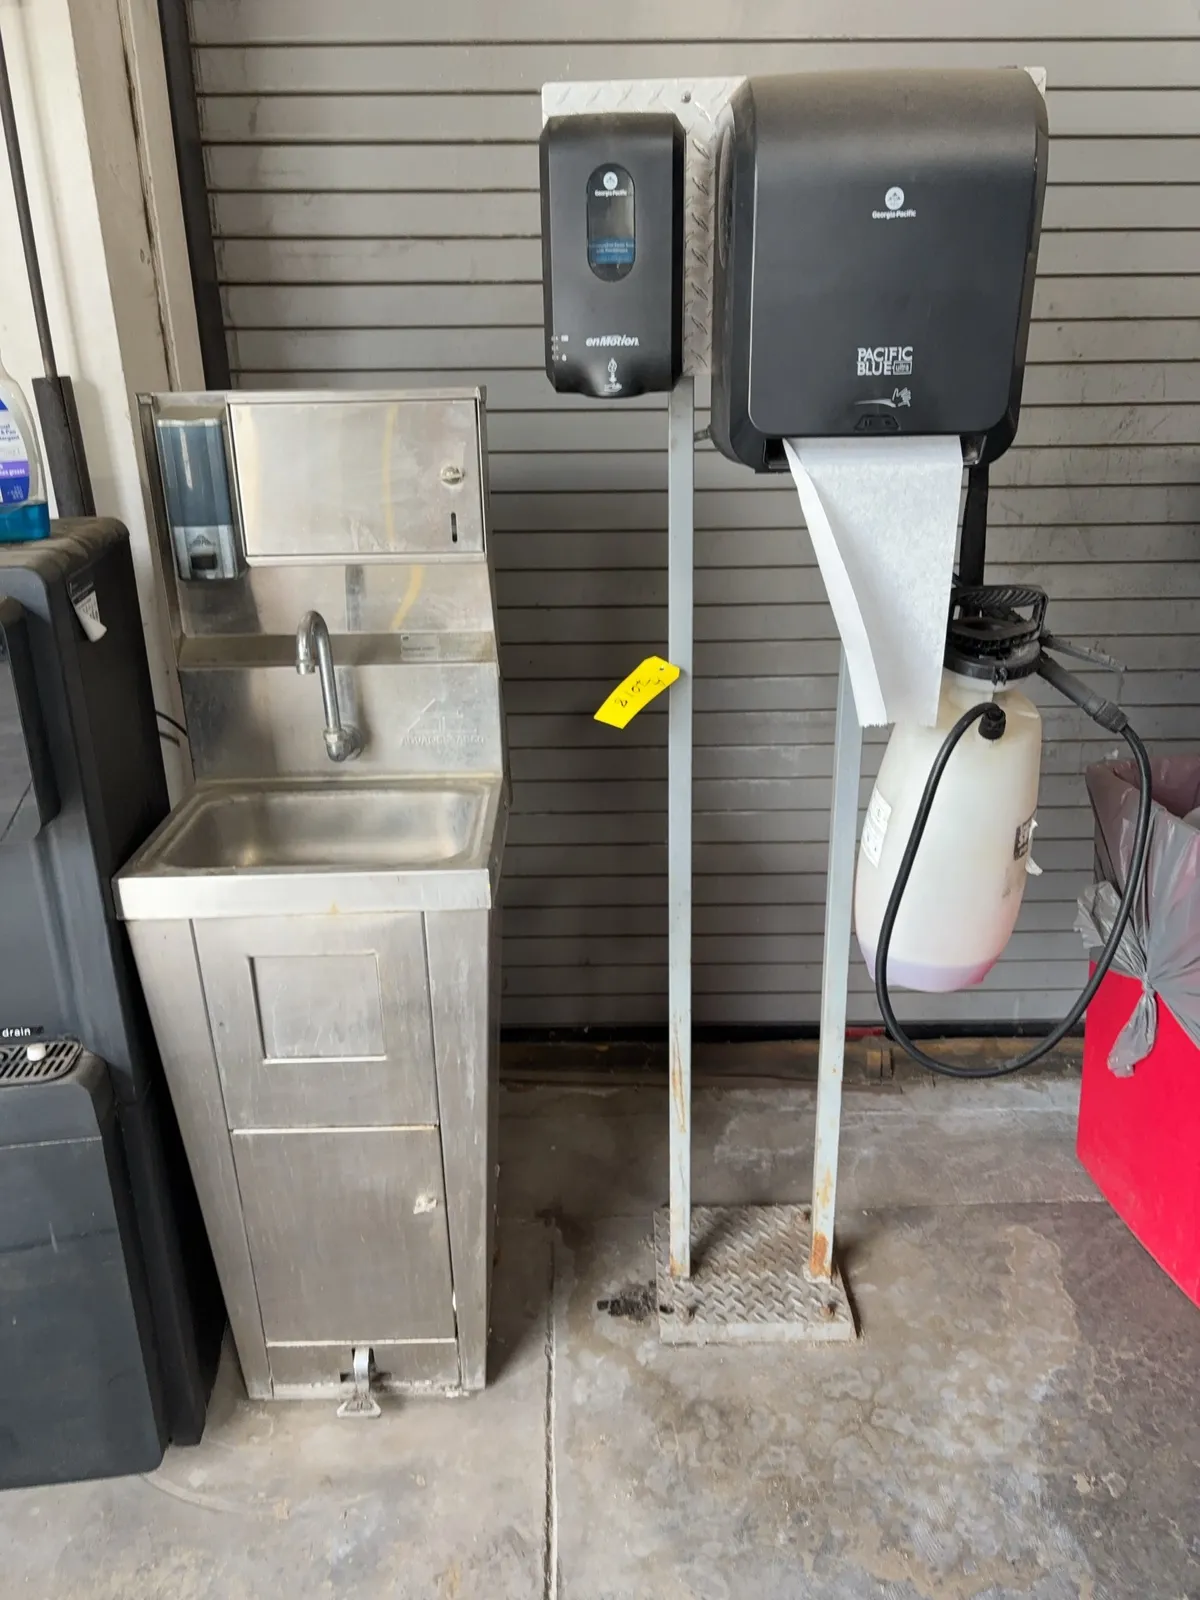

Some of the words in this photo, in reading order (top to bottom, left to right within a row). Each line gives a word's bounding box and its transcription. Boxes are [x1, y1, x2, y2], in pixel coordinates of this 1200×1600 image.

[586, 334, 639, 347] enMotion
[857, 346, 913, 362] PACIFIC
[857, 361, 892, 376] BLUE
[2, 1027, 31, 1037] drain
